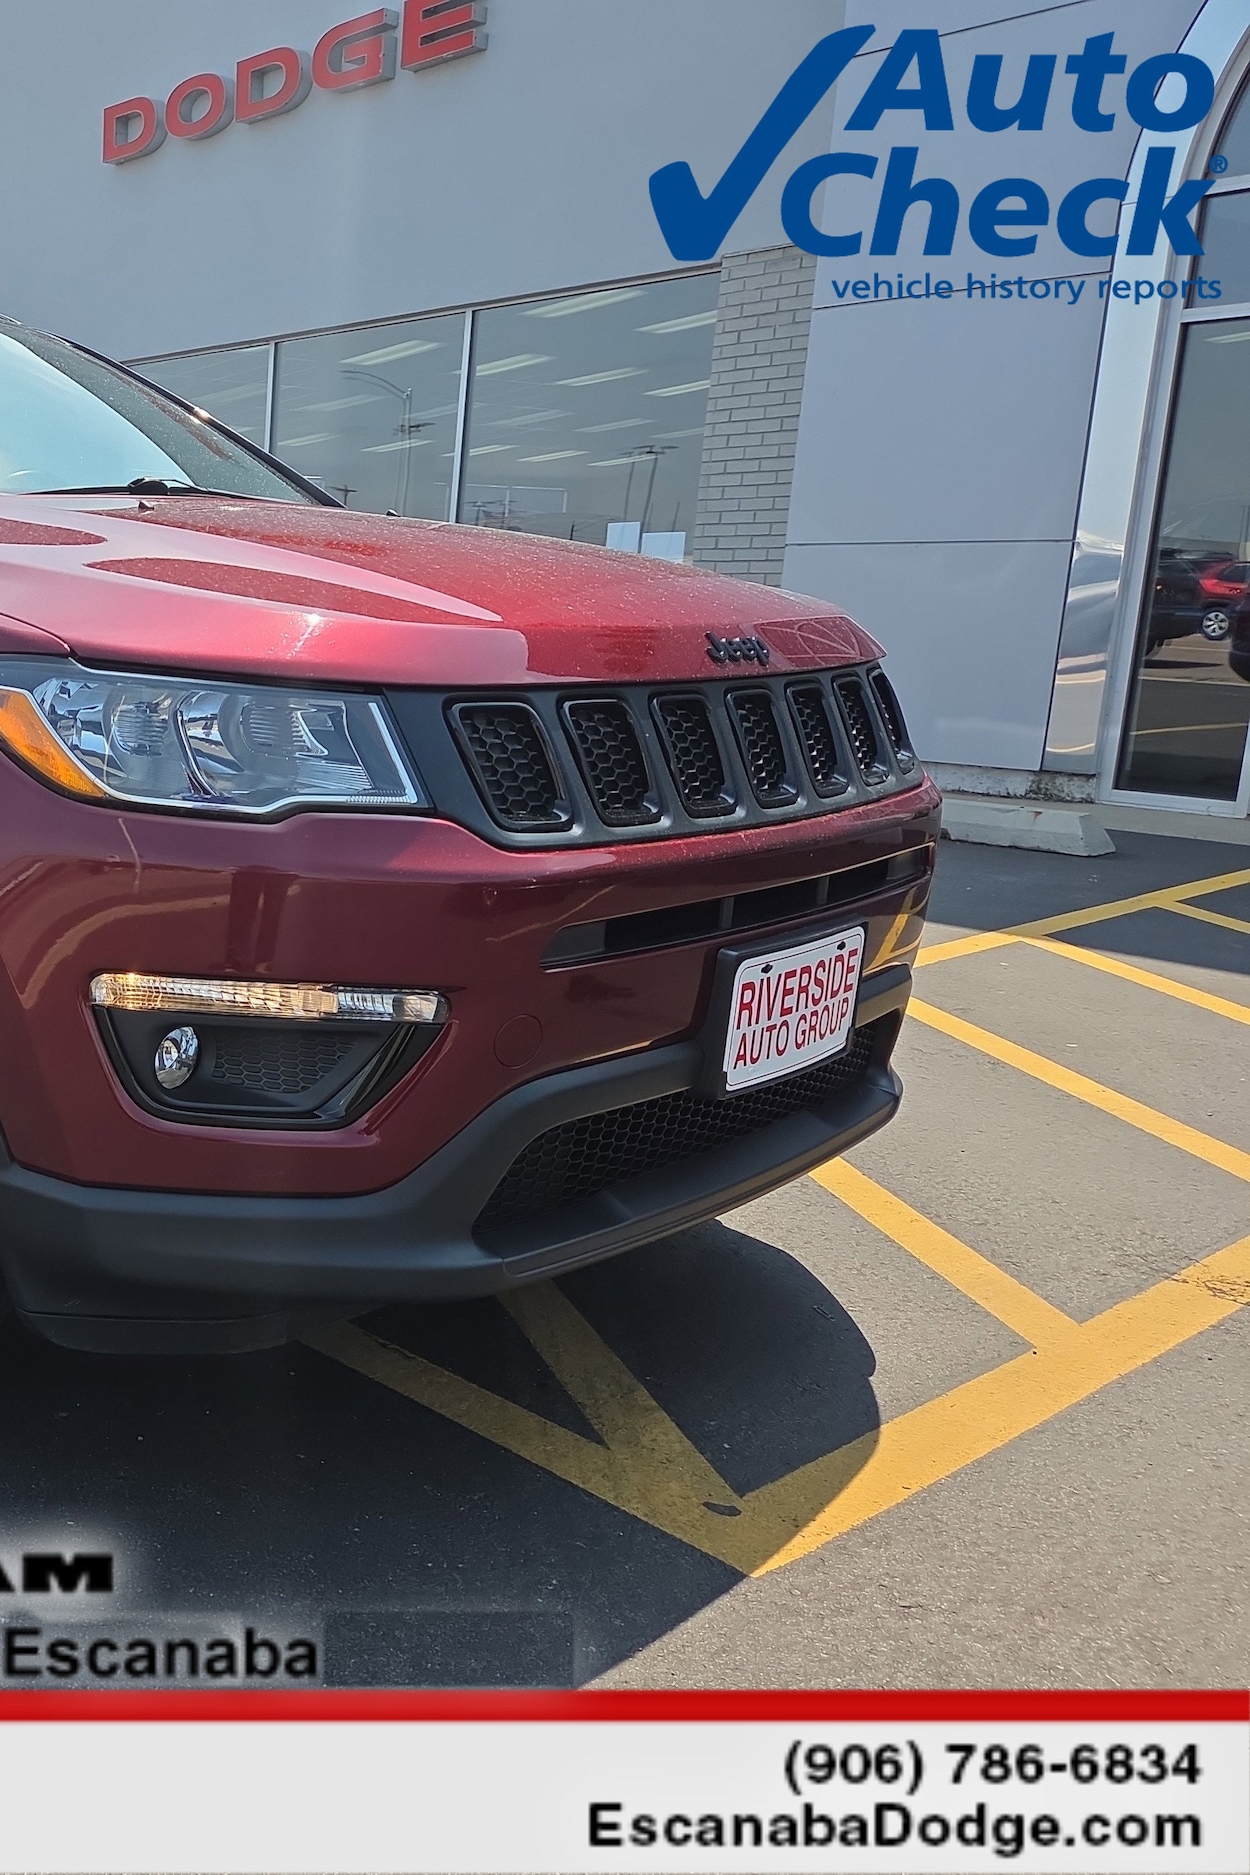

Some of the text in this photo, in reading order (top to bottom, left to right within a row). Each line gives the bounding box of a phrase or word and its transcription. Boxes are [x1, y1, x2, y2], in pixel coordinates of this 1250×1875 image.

[102, 0, 488, 165] DODGE
[704, 630, 771, 667] Jeep
[736, 947, 858, 1030] RIVERSIDE
[733, 996, 849, 1070] AUTO GROUP
